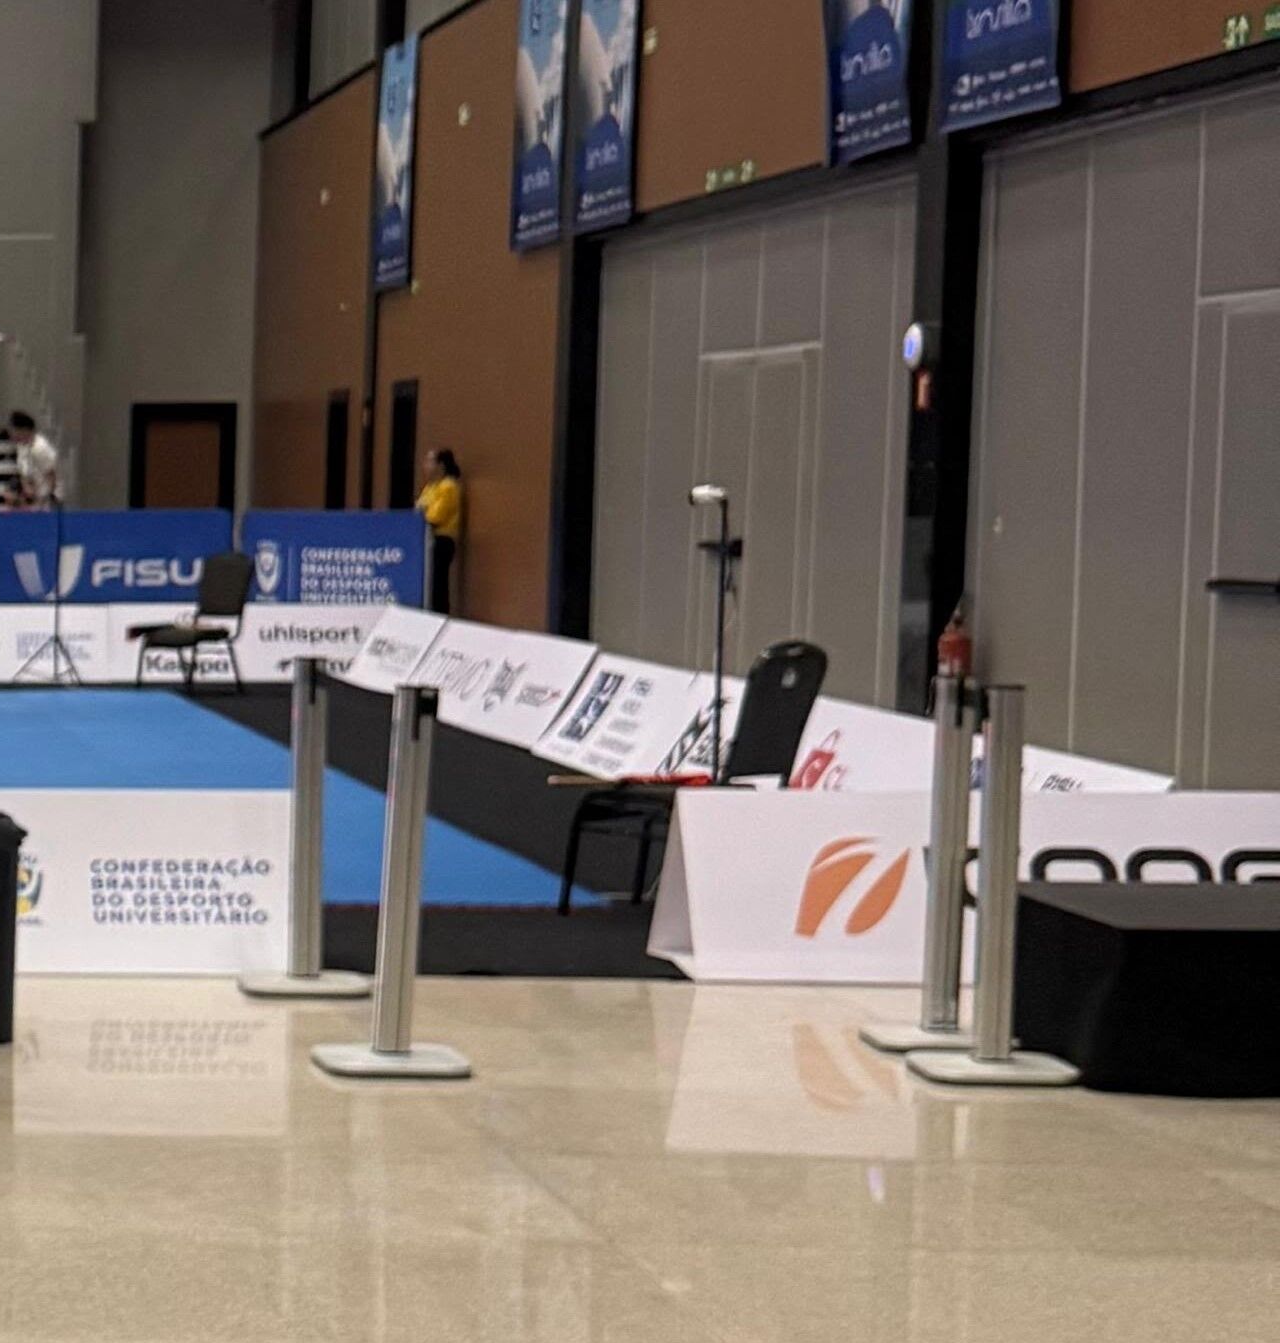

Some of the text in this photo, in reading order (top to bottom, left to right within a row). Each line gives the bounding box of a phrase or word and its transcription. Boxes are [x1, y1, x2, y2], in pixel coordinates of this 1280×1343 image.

[91, 557, 203, 587] FISU
[259, 623, 362, 644] uhlsport
[90, 855, 271, 879] CONFEDERAÇÃO
[91, 878, 221, 891] BRASILEIRA
[92, 894, 253, 908] DO DESPORTO
[93, 907, 269, 925] UNIVERSITÁRIO
